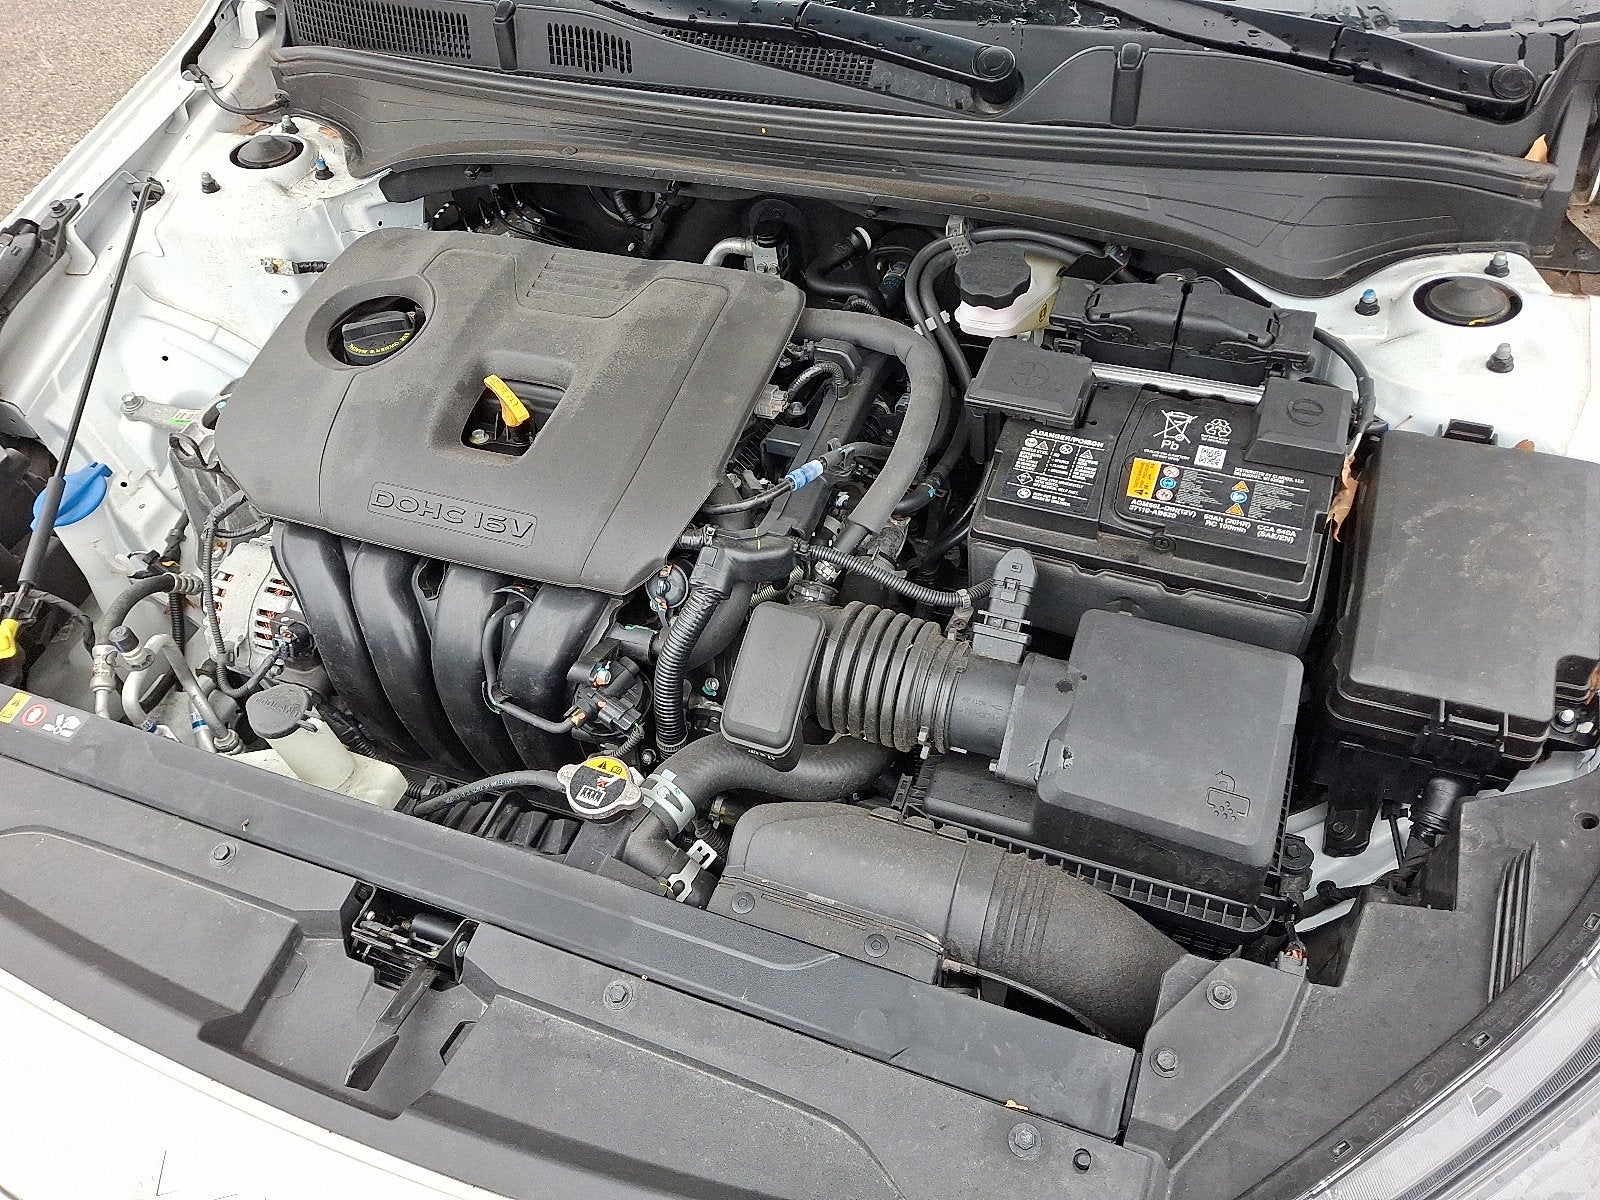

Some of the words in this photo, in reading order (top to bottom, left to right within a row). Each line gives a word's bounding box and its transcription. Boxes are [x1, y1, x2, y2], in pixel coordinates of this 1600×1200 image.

[1037, 430, 1105, 448] DANGER/POISON
[1160, 439, 1180, 451] Pb
[371, 489, 467, 524] DOHC
[473, 511, 534, 538] 16V
[1204, 519, 1218, 528] RC
[1219, 522, 1247, 534] 100min
[1256, 524, 1275, 533] CCA
